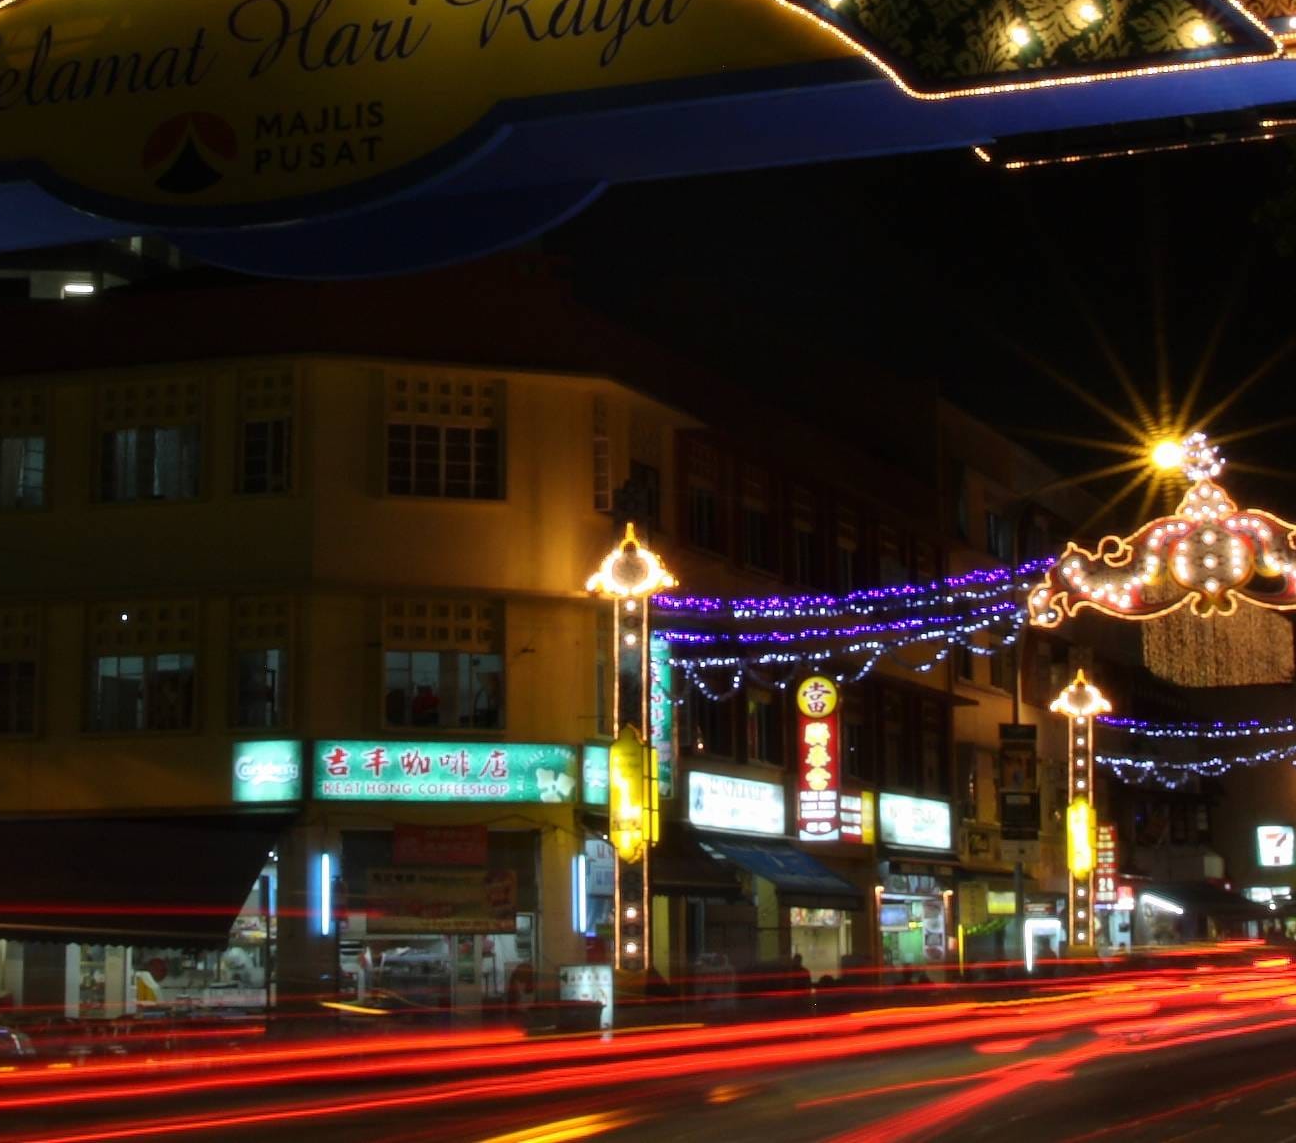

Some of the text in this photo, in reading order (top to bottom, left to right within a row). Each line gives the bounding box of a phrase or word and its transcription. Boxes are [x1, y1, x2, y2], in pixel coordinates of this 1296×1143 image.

[254, 101, 385, 140] MAJLIS
[254, 136, 384, 176] PUSAT
[323, 782, 508, 796] KEAT HONG COFFEESHOP
